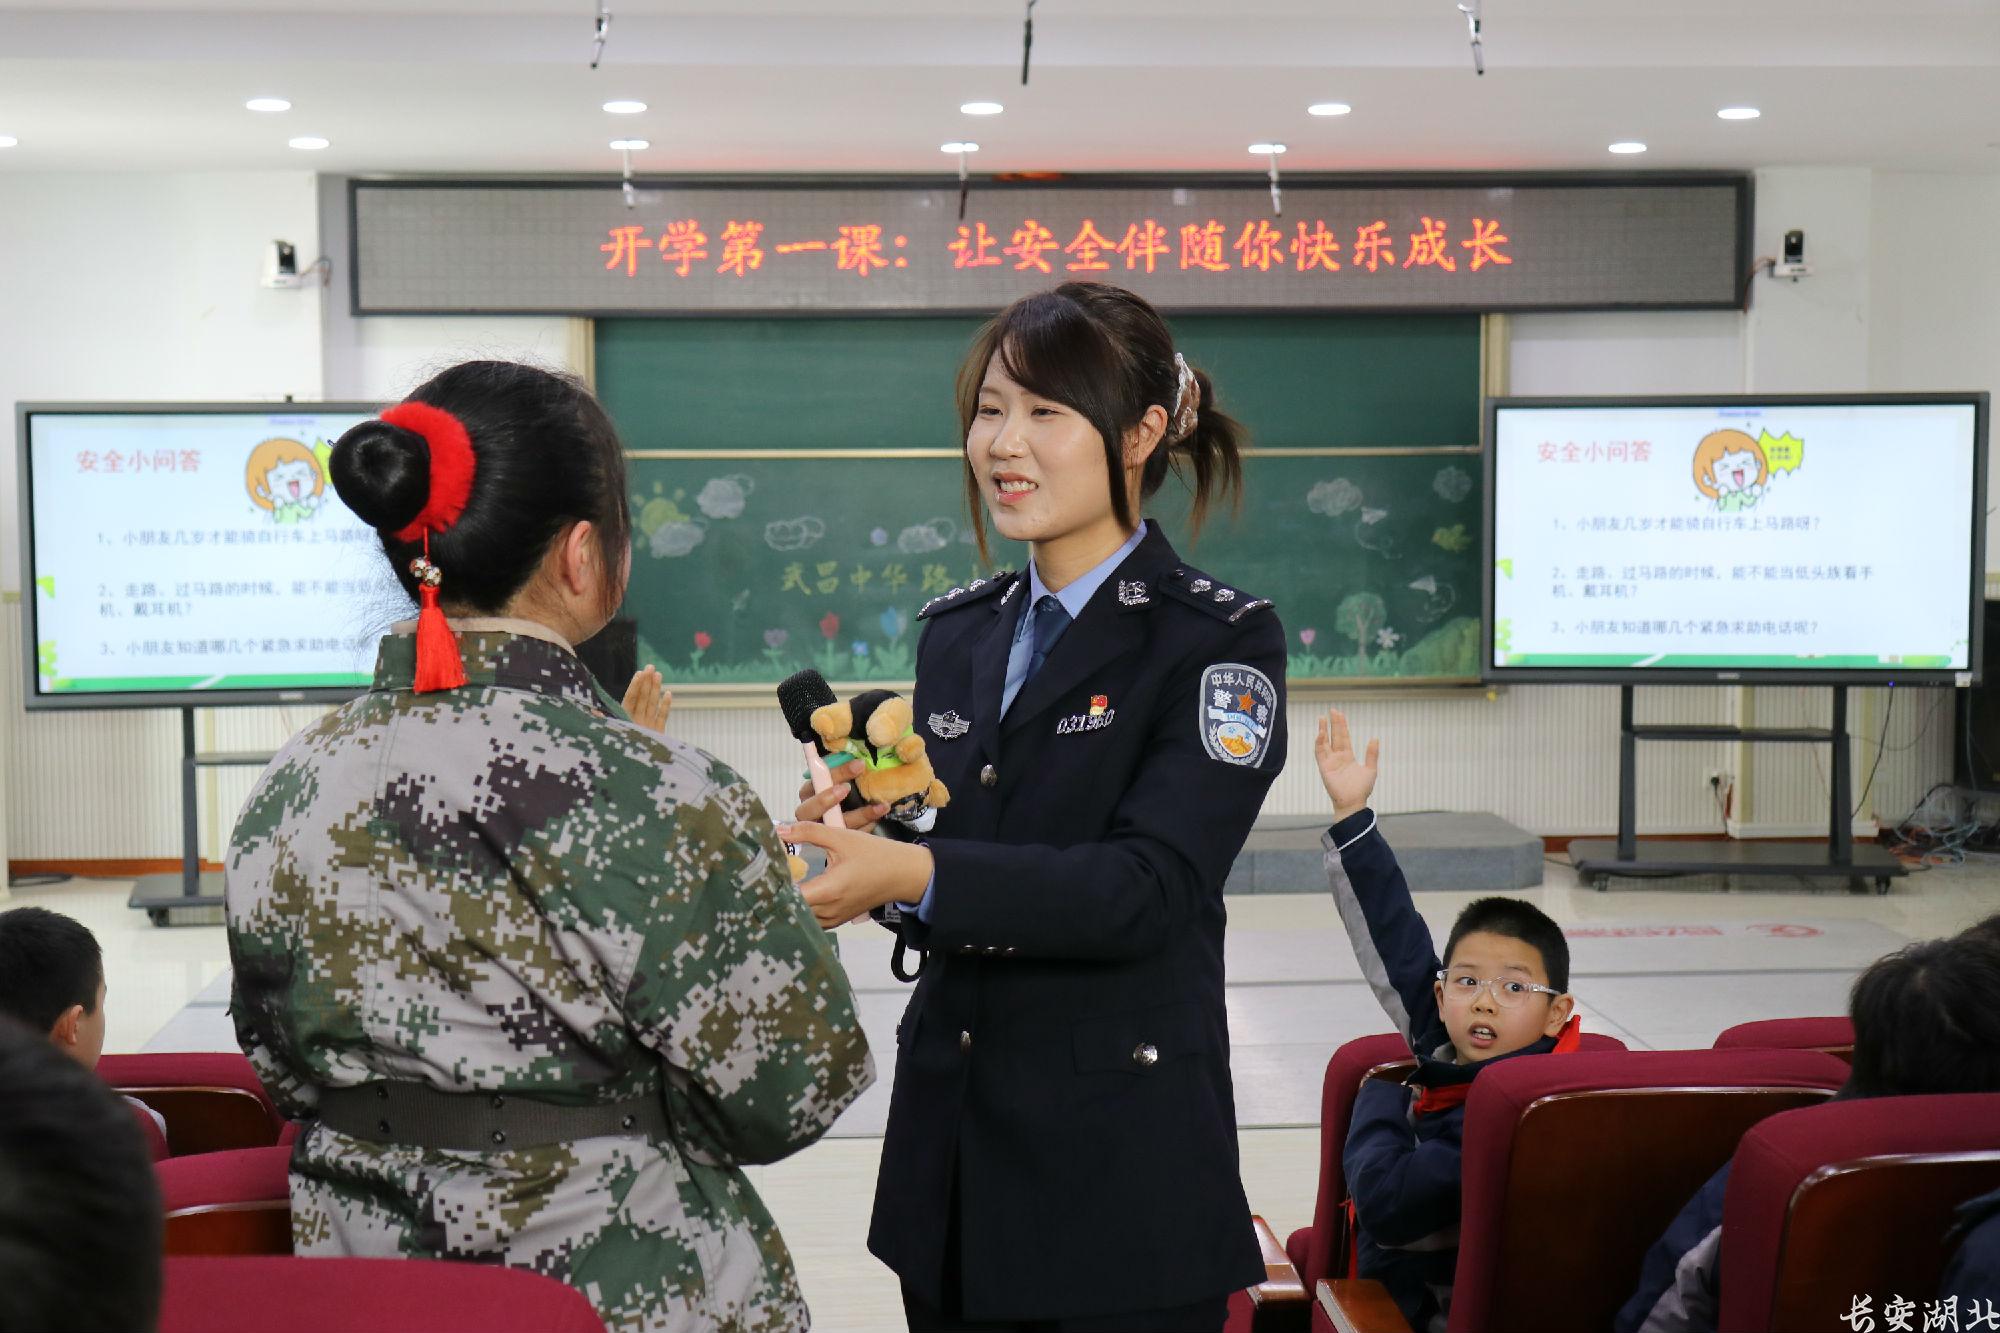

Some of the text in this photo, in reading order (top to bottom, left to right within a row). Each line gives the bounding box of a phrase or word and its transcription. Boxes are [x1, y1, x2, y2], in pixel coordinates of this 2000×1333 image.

[601, 217, 1513, 277] 开学第一课：让安全伴随你快乐成长
[76, 449, 201, 473] 安全小问答
[1537, 441, 1652, 463] 安全小问答
[1213, 688, 1233, 709] 警
